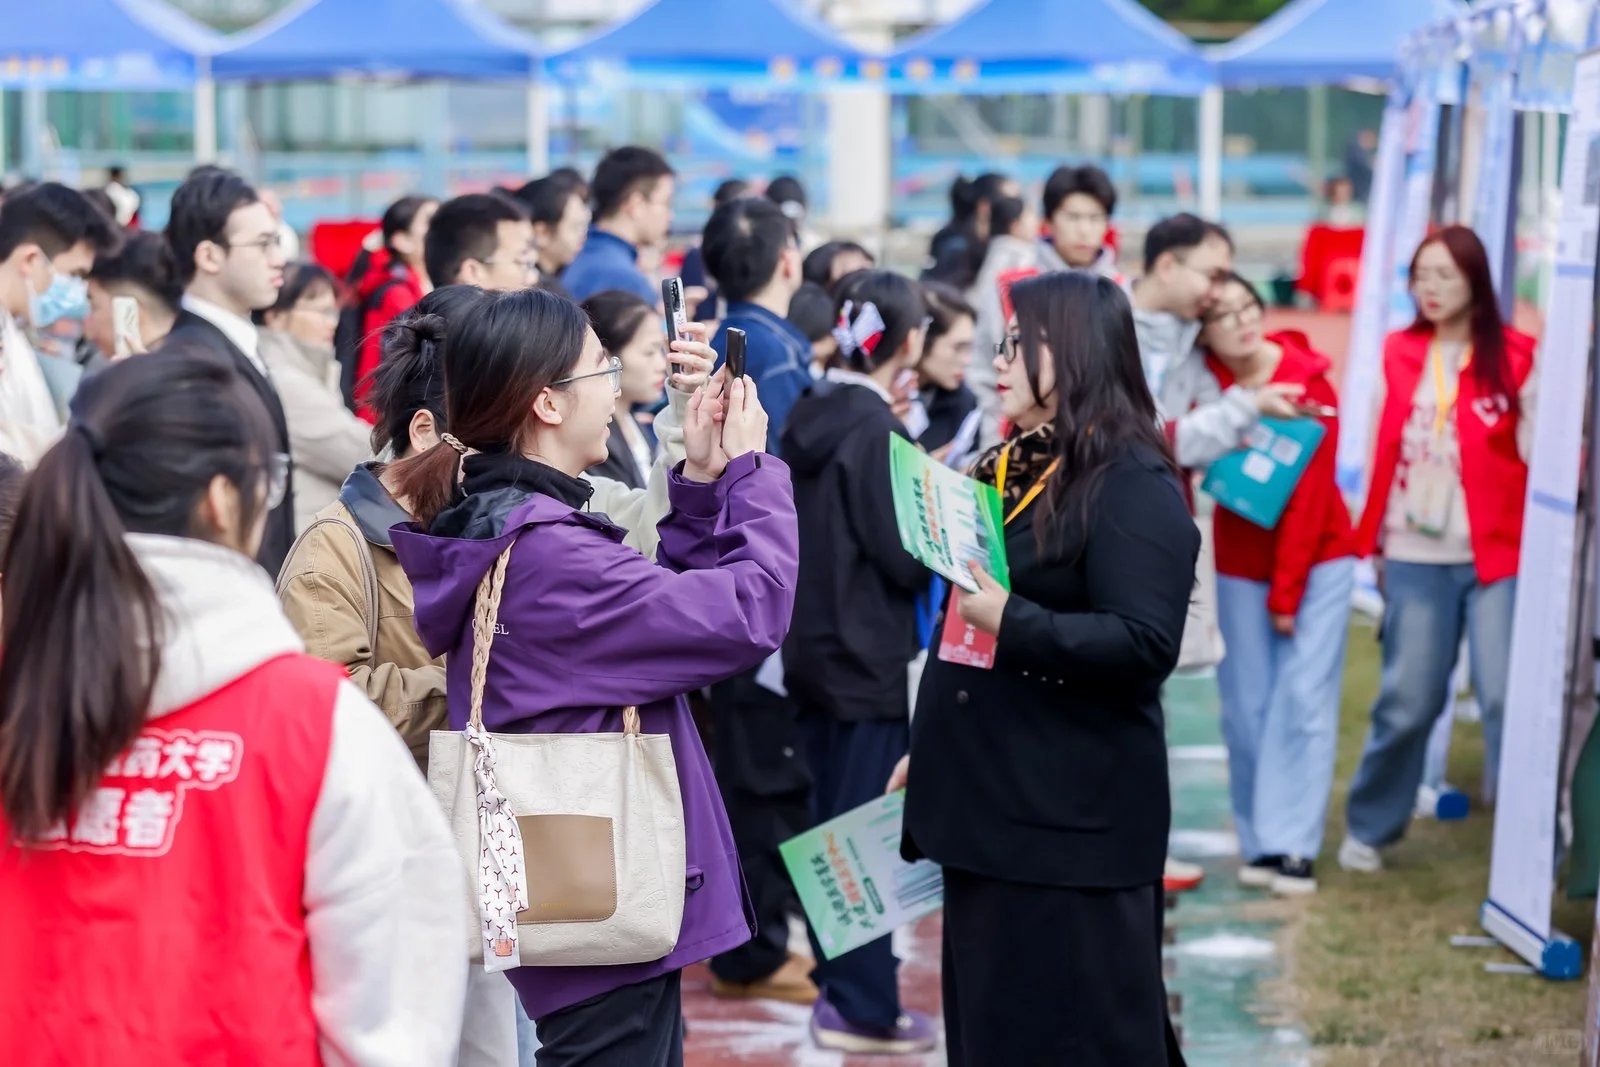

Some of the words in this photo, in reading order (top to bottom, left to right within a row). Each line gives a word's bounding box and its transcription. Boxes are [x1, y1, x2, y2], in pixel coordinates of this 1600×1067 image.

[104, 737, 234, 781] 药大学
[37, 787, 175, 848] 愿者
